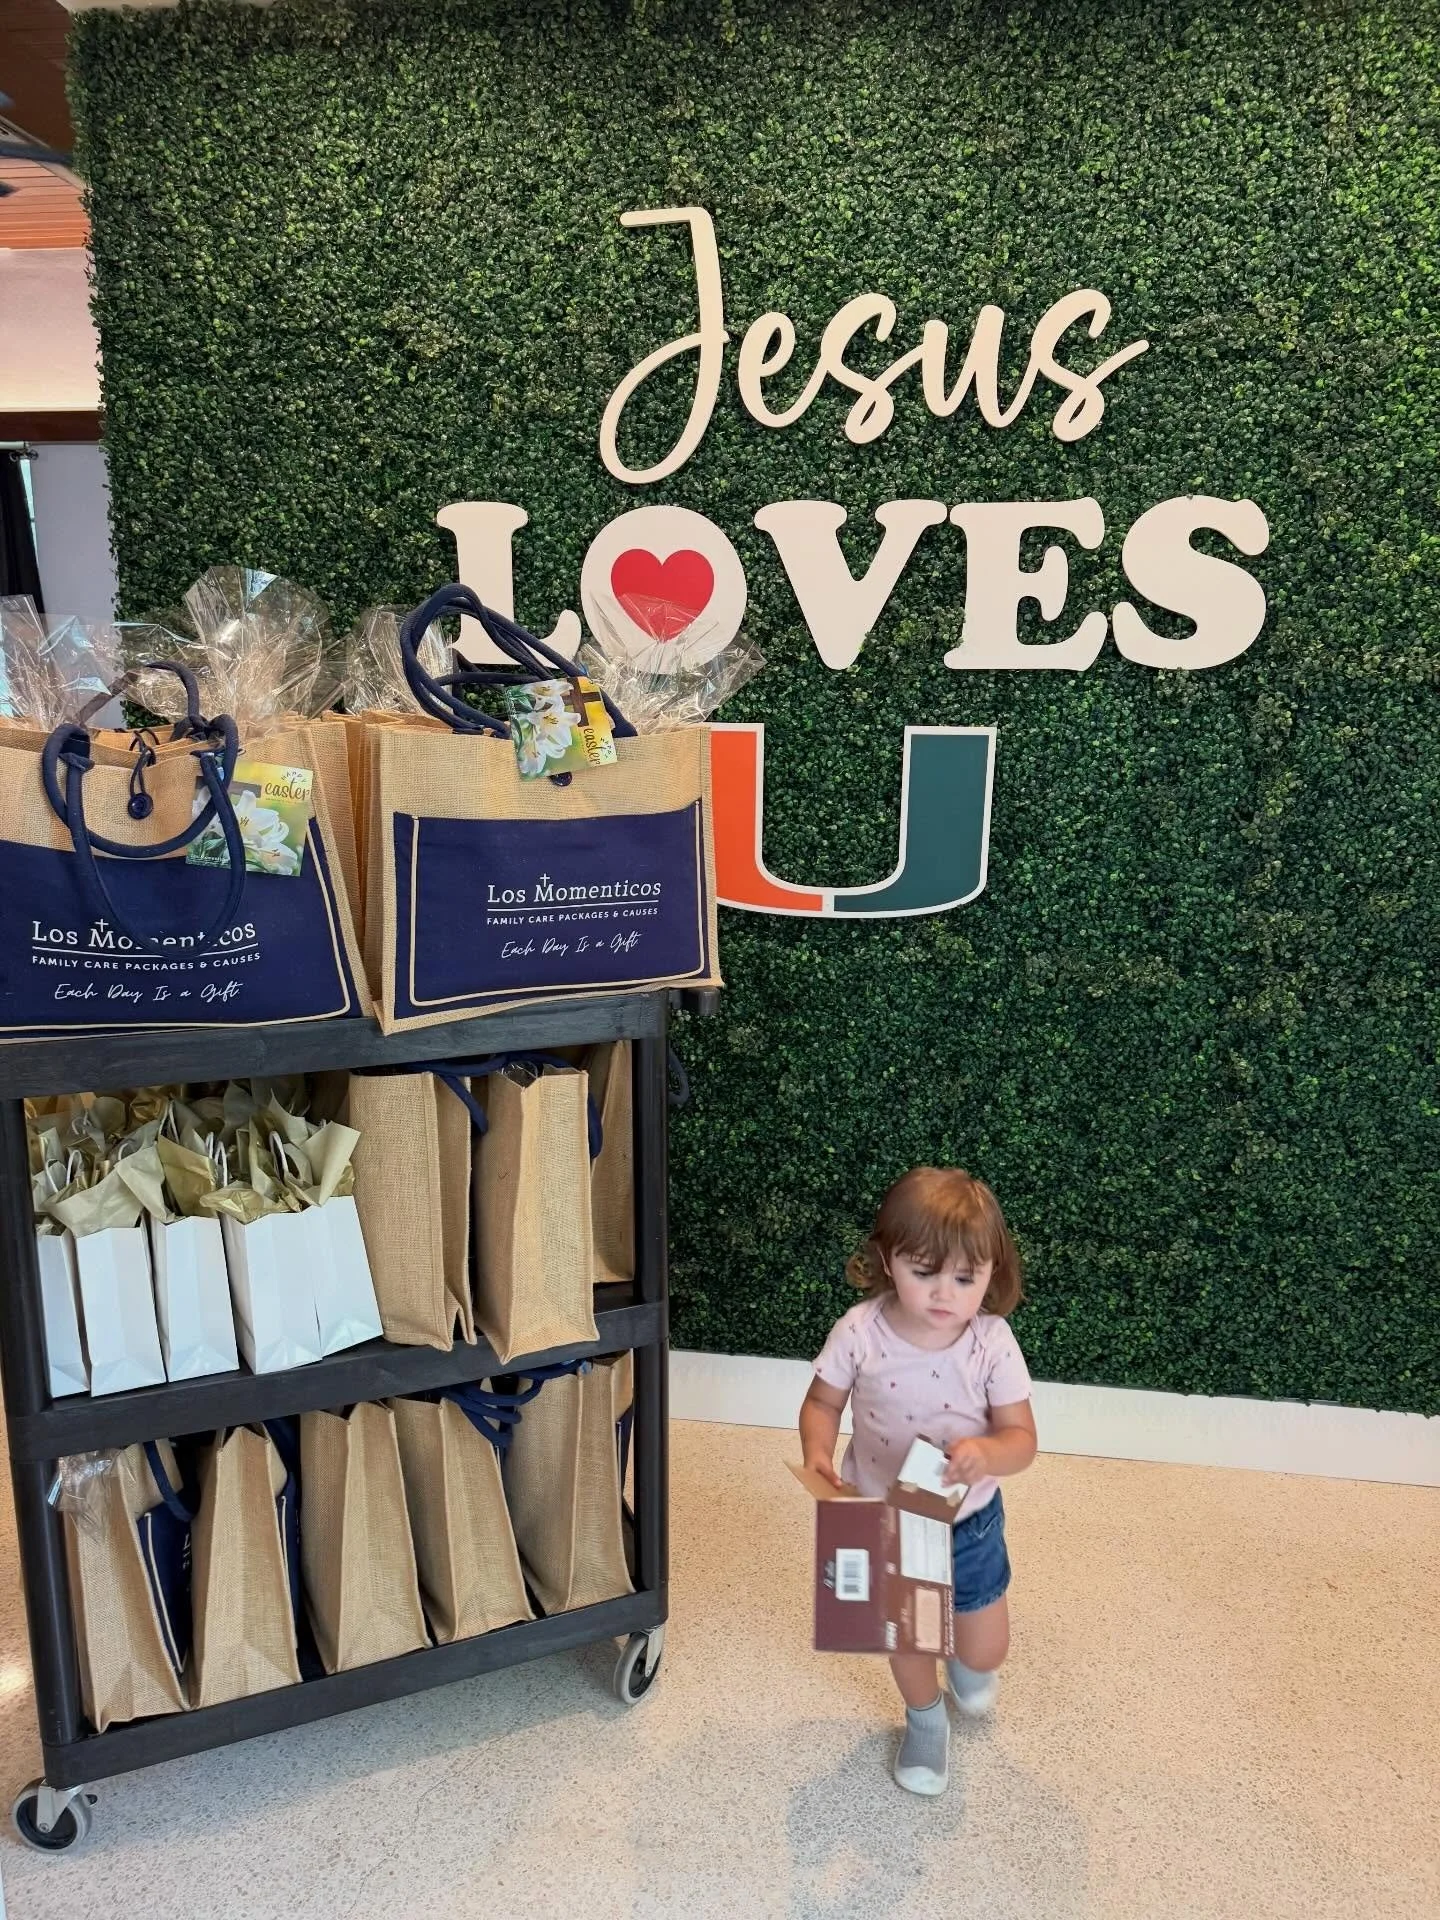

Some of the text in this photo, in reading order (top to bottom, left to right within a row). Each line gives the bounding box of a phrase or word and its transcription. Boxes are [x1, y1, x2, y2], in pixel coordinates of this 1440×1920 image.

[600, 207, 1149, 485] Jesus
[436, 495, 1270, 673] LOVES
[265, 778, 310, 800] easter
[487, 879, 662, 904] Los Momenticos
[487, 907, 659, 926] FAMILY CARE PACKAGES & CAUSES
[32, 920, 79, 946] Los
[501, 938, 536, 959] Each
[541, 937, 570, 957] Day
[574, 935, 590, 953] Is
[609, 930, 643, 954] Gift
[32, 952, 261, 971] FAMILY CARE PACKAGES & CAUSES
[54, 980, 244, 1003] Each Day Is a Gift
